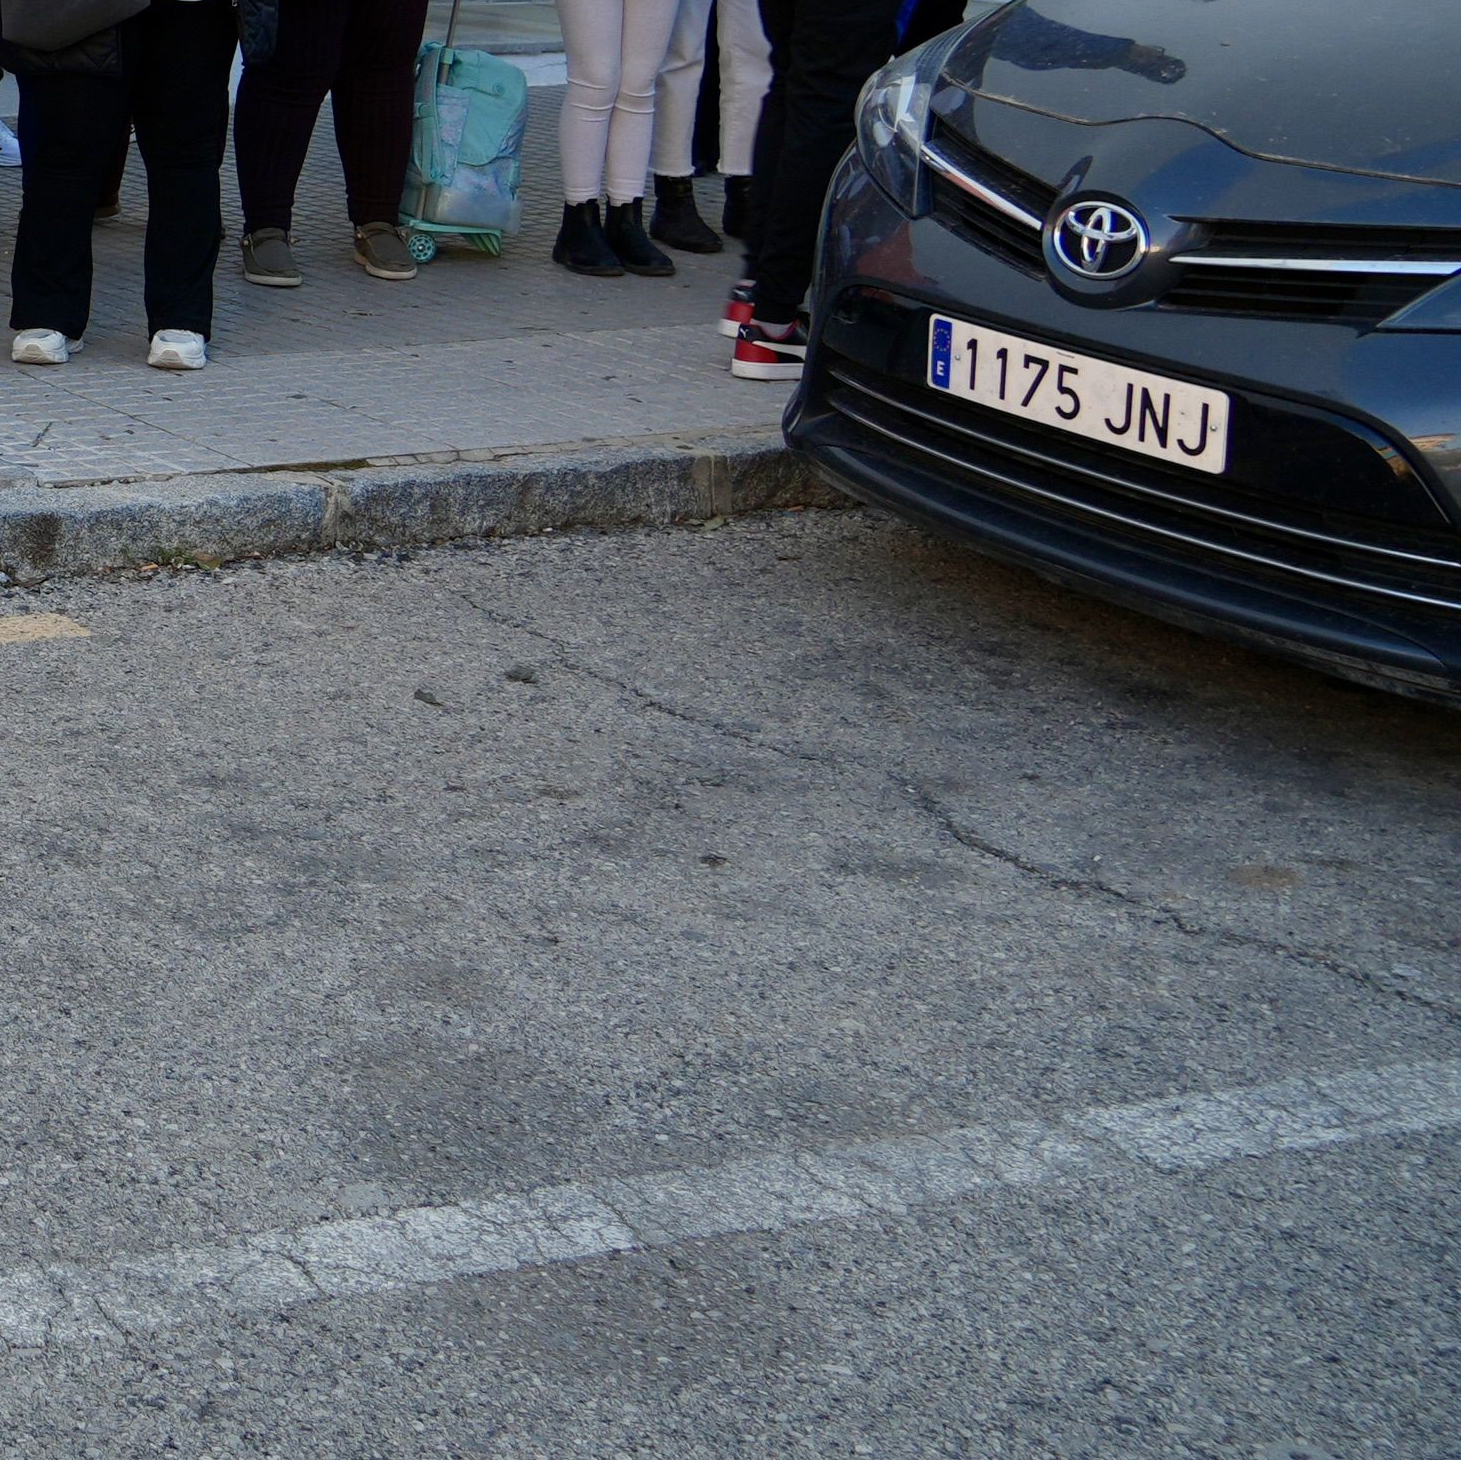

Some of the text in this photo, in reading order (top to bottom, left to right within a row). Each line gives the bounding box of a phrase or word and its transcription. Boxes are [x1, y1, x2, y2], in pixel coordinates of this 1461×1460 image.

[936, 338, 1210, 456] E 1175 JNJ
